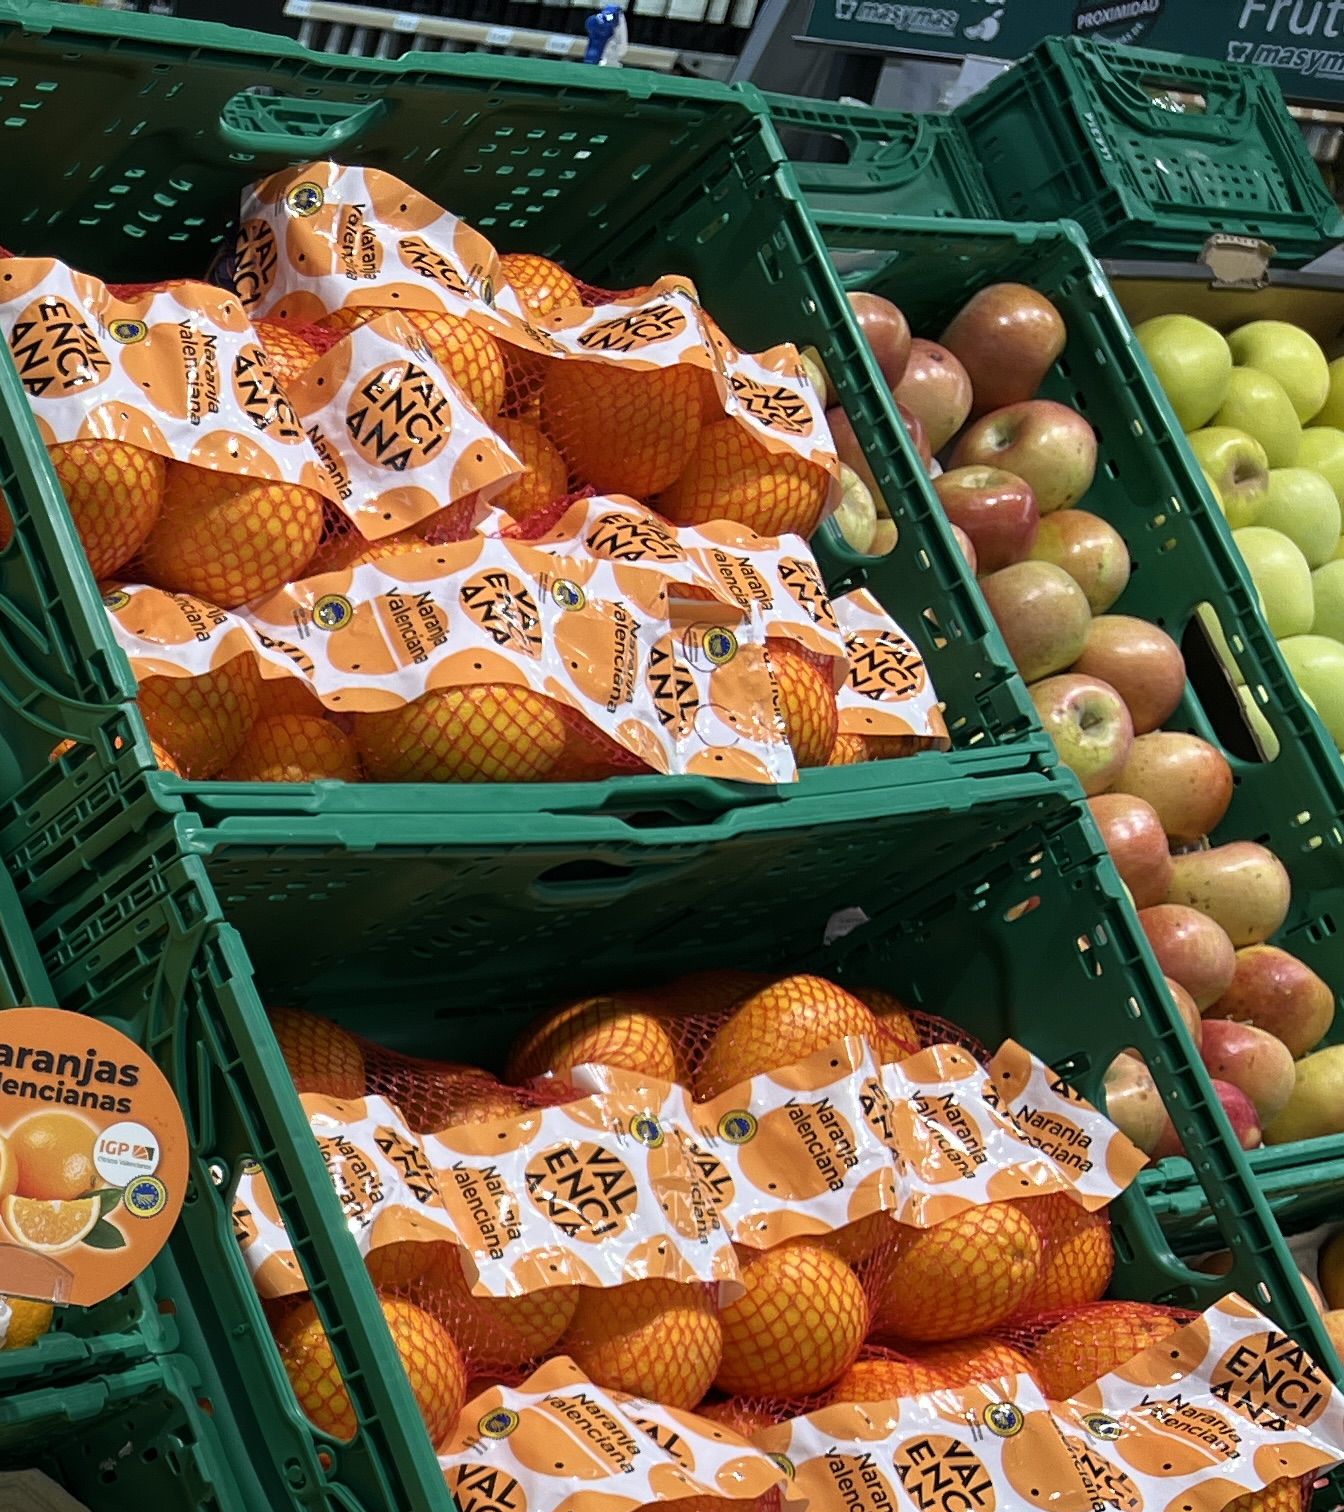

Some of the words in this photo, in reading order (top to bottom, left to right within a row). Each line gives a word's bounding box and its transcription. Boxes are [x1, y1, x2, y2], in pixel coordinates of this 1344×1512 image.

[1076, 0, 1161, 29] PROXIMIDAD
[1238, 0, 1344, 38] Frut
[11, 321, 55, 397] ANA
[38, 302, 92, 389] ENCI
[178, 319, 201, 427] valenciana
[200, 334, 220, 414] Naranja
[361, 371, 443, 455] ENCI
[404, 363, 450, 426] VAL
[305, 424, 353, 502] Naranja
[345, 406, 416, 472] ANA
[460, 585, 511, 645] ANA
[735, 556, 773, 612] Naranja
[385, 586, 429, 665] valenciana
[413, 590, 449, 648] Naranja
[606, 601, 627, 713] valenciana
[650, 647, 675, 726] ANA
[99, 1140, 130, 1156] IGP
[784, 1097, 845, 1192] valenciana
[812, 1096, 859, 1169] Naranja
[938, 1091, 988, 1167] Naranja
[1015, 1104, 1093, 1150] Naranja
[452, 1160, 504, 1262] valenciana
[526, 1172, 580, 1240] ANA
[545, 1149, 619, 1238] ENCI
[586, 1146, 638, 1217] VAL
[1224, 1345, 1323, 1421] ENCI
[1264, 1331, 1322, 1386] VAL
[542, 1393, 635, 1475] valenciana
[572, 1392, 641, 1456] Naranja
[1137, 1394, 1241, 1461] valenciana
[1168, 1393, 1243, 1447] Naranja
[1209, 1381, 1287, 1433] ANA
[457, 1463, 519, 1510] VAL
[941, 1440, 994, 1508] VAL
